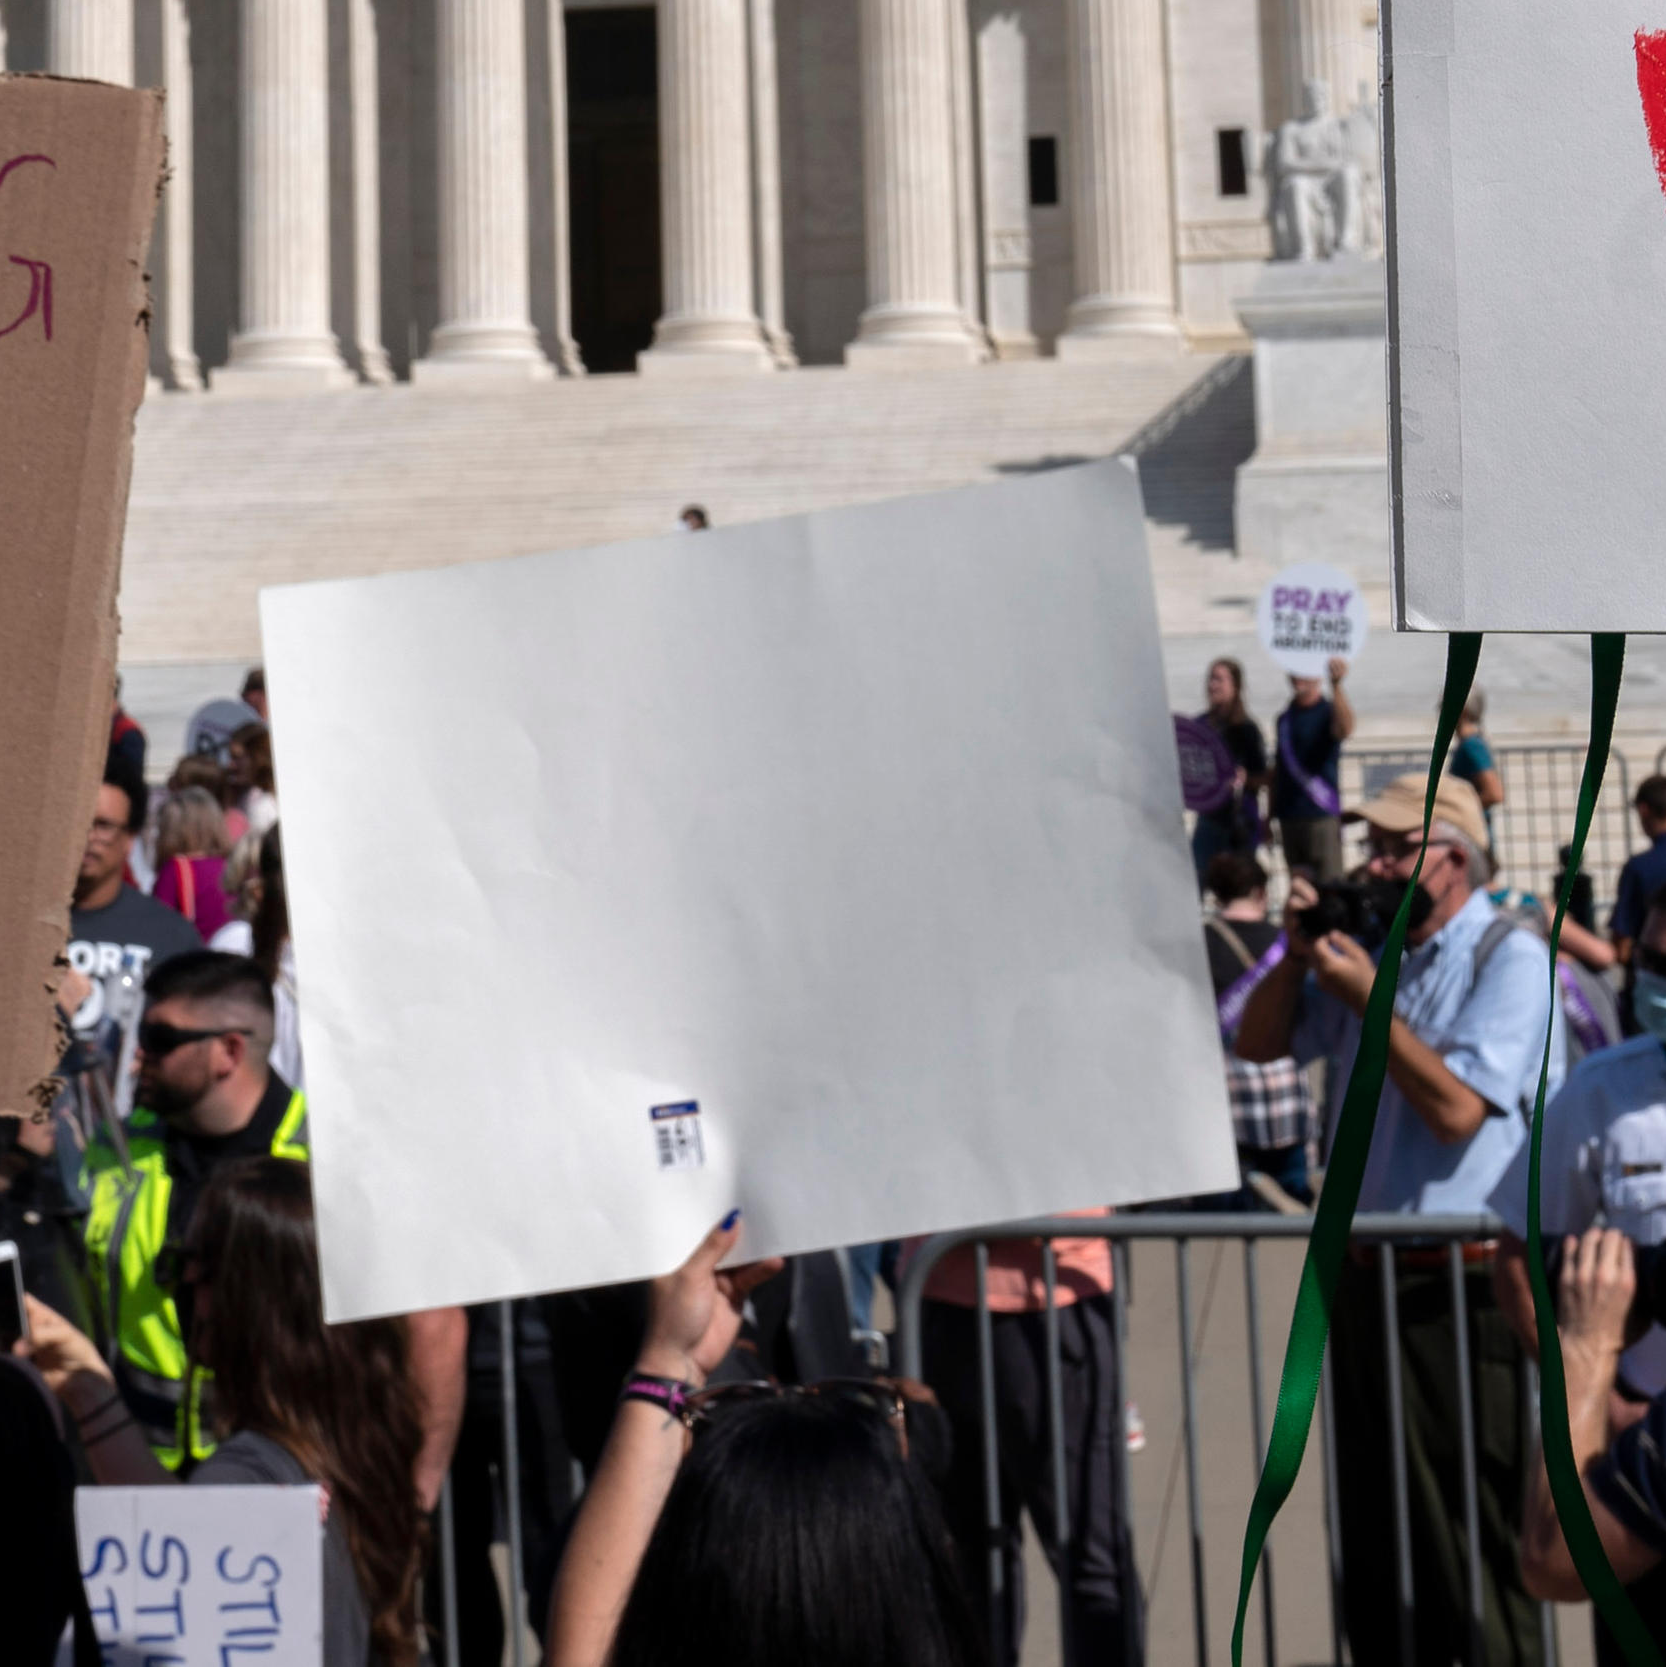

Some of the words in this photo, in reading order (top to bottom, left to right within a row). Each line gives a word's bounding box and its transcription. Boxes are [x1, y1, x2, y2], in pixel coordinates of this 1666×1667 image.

[1272, 586, 1352, 613] PRAY
[1273, 612, 1302, 633] TO
[1308, 613, 1352, 637] END
[67, 940, 152, 976] ORT
